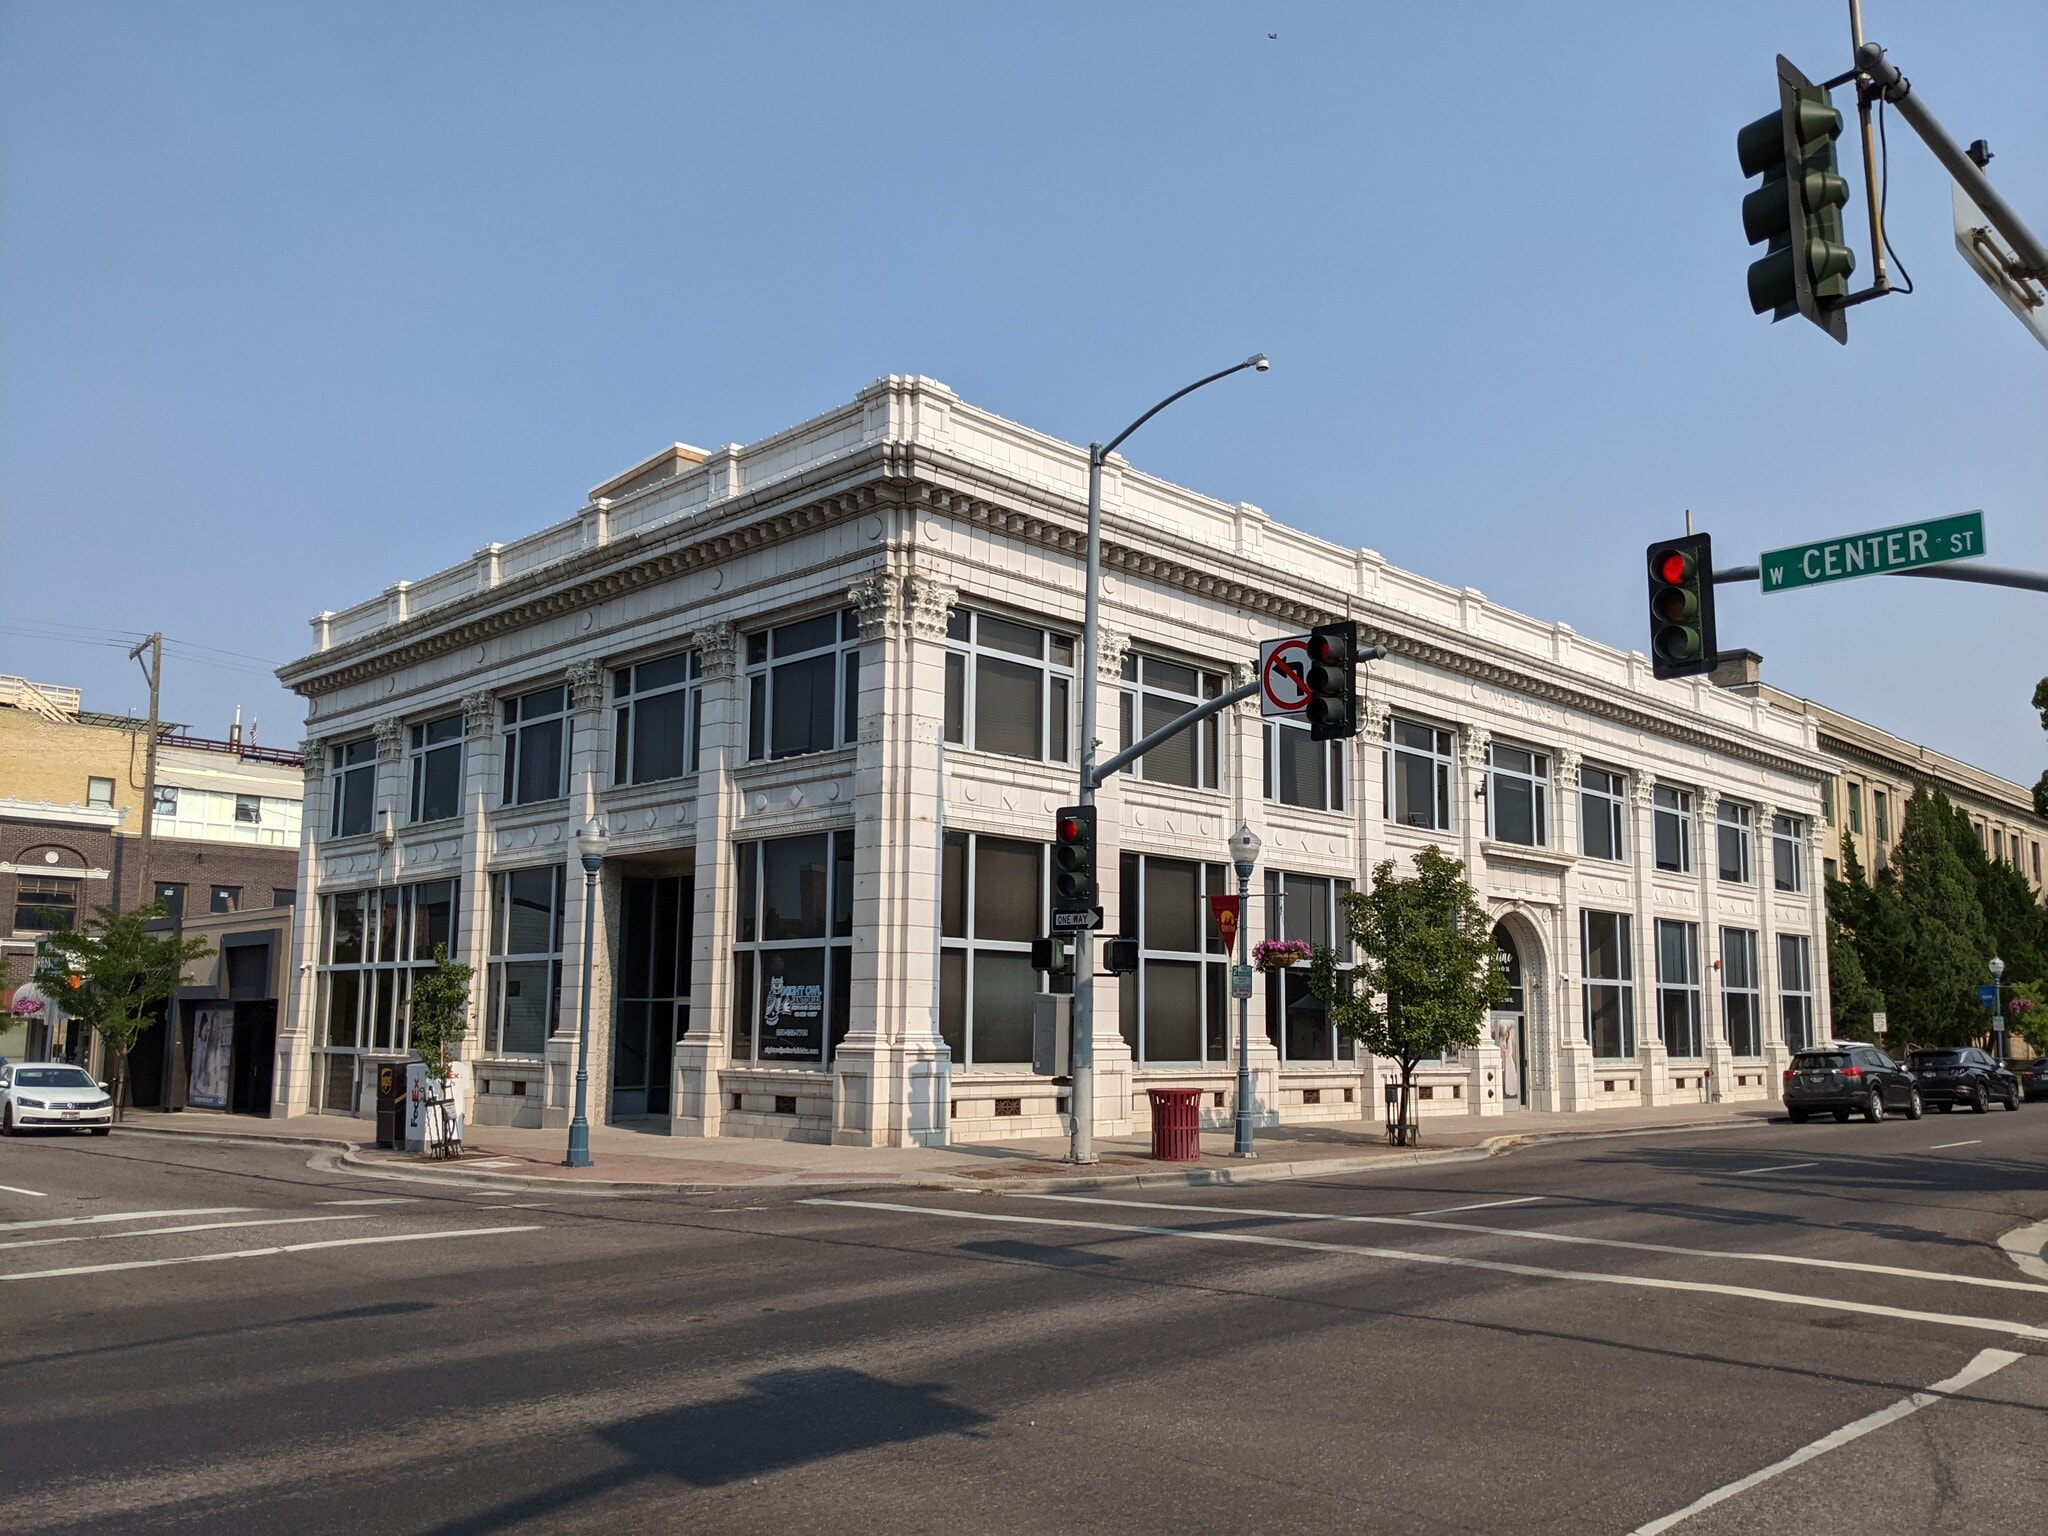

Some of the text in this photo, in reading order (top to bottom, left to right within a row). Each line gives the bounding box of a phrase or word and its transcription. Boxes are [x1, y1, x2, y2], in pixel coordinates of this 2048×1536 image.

[1769, 529, 1974, 585] W CENTER ST
[1491, 689, 1552, 720] VALENTINE
[1057, 914, 1088, 925] ONE WAY
[1233, 967, 1239, 976] 2
[783, 985, 822, 996] NIGHT OWL
[411, 1078, 420, 1128] FedEx
